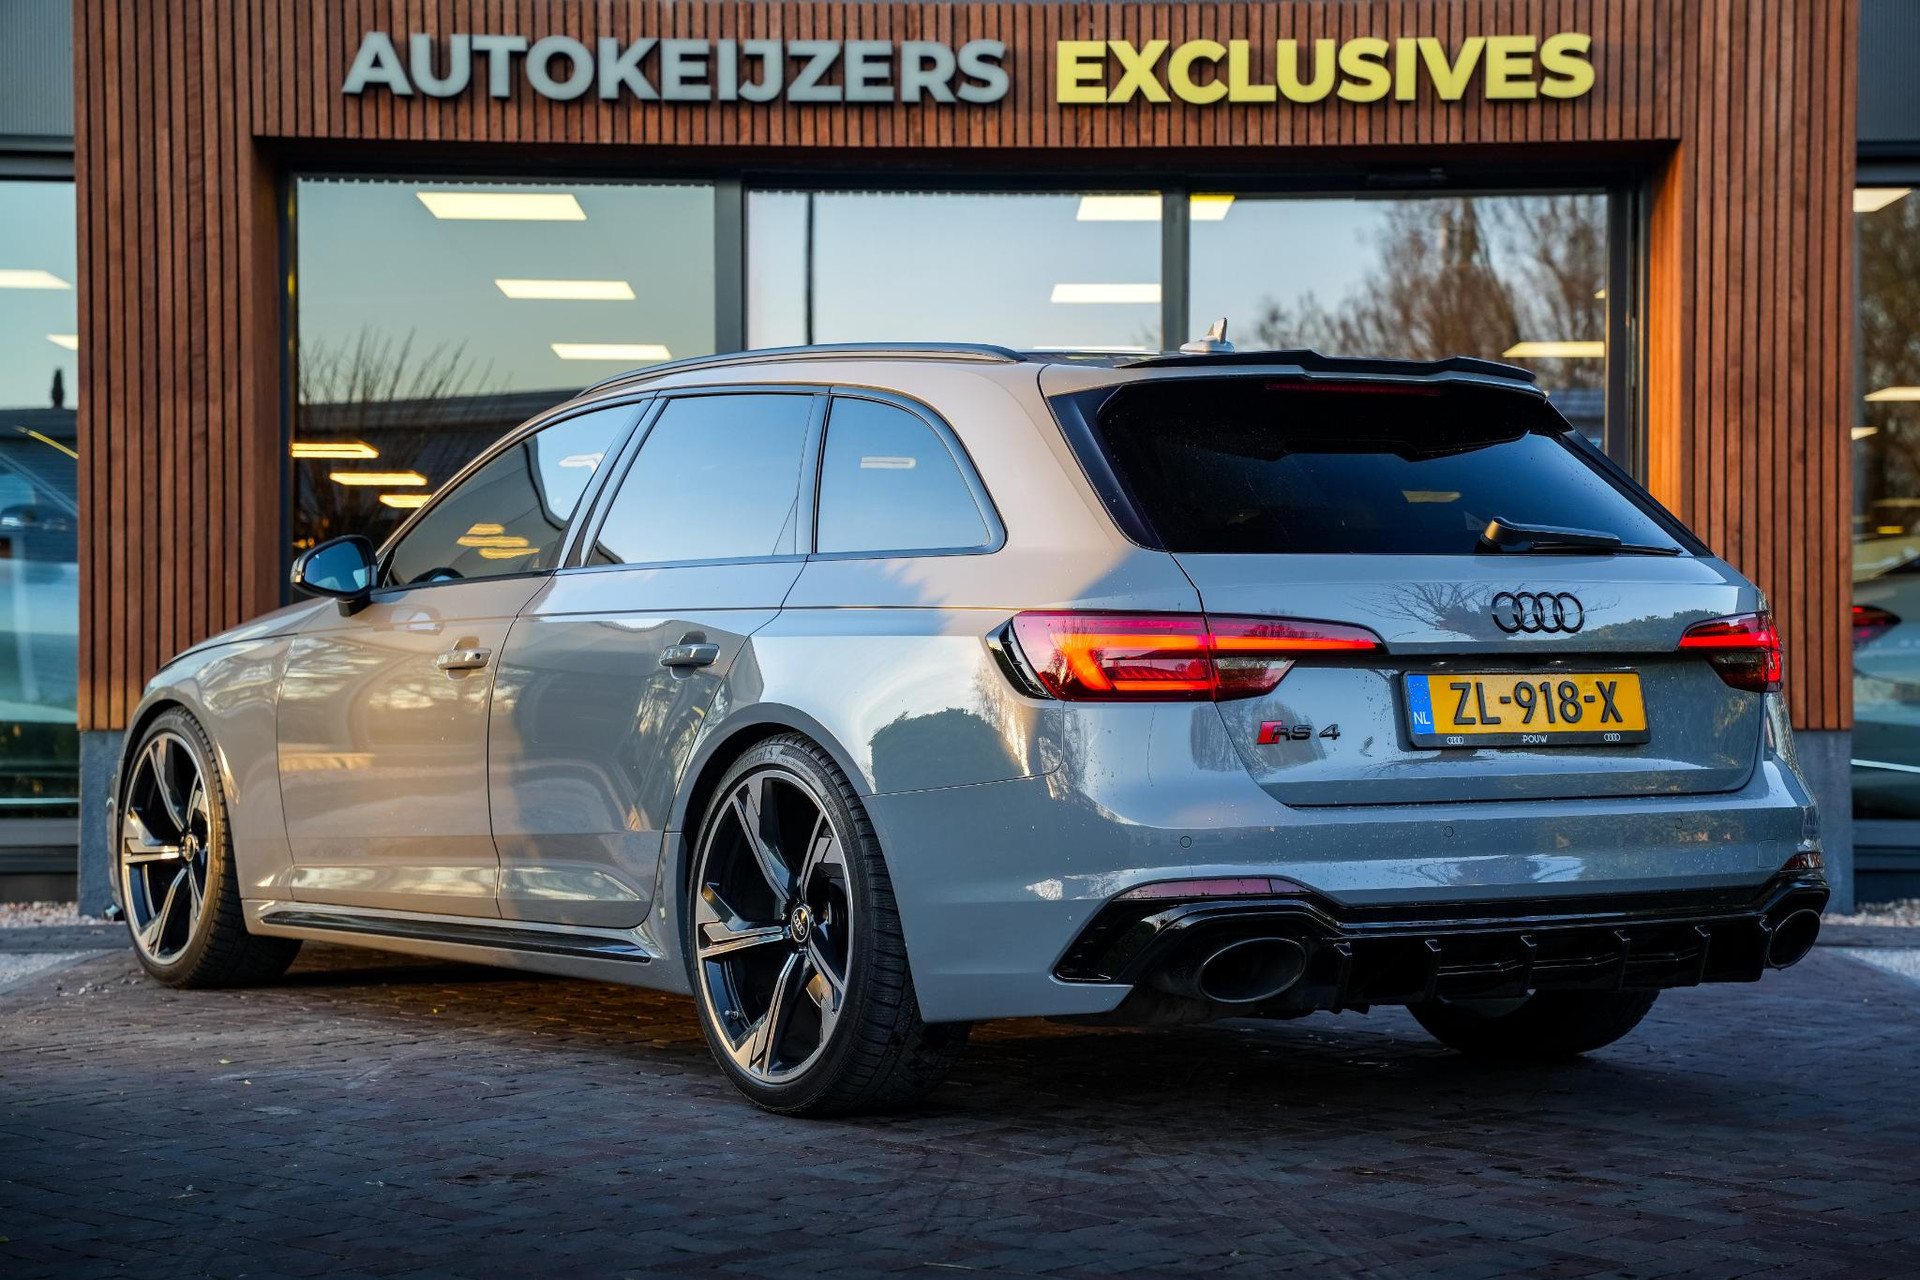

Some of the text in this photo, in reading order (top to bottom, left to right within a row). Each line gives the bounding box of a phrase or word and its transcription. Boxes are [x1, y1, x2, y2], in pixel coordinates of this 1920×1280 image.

[341, 31, 1596, 104] AUTOKEIJZERS EXCLUSIVES
[1450, 680, 1623, 725] ZL-918-X
[1413, 711, 1431, 725] NL
[1319, 723, 1341, 740] 4
[1522, 735, 1548, 744] POUW
